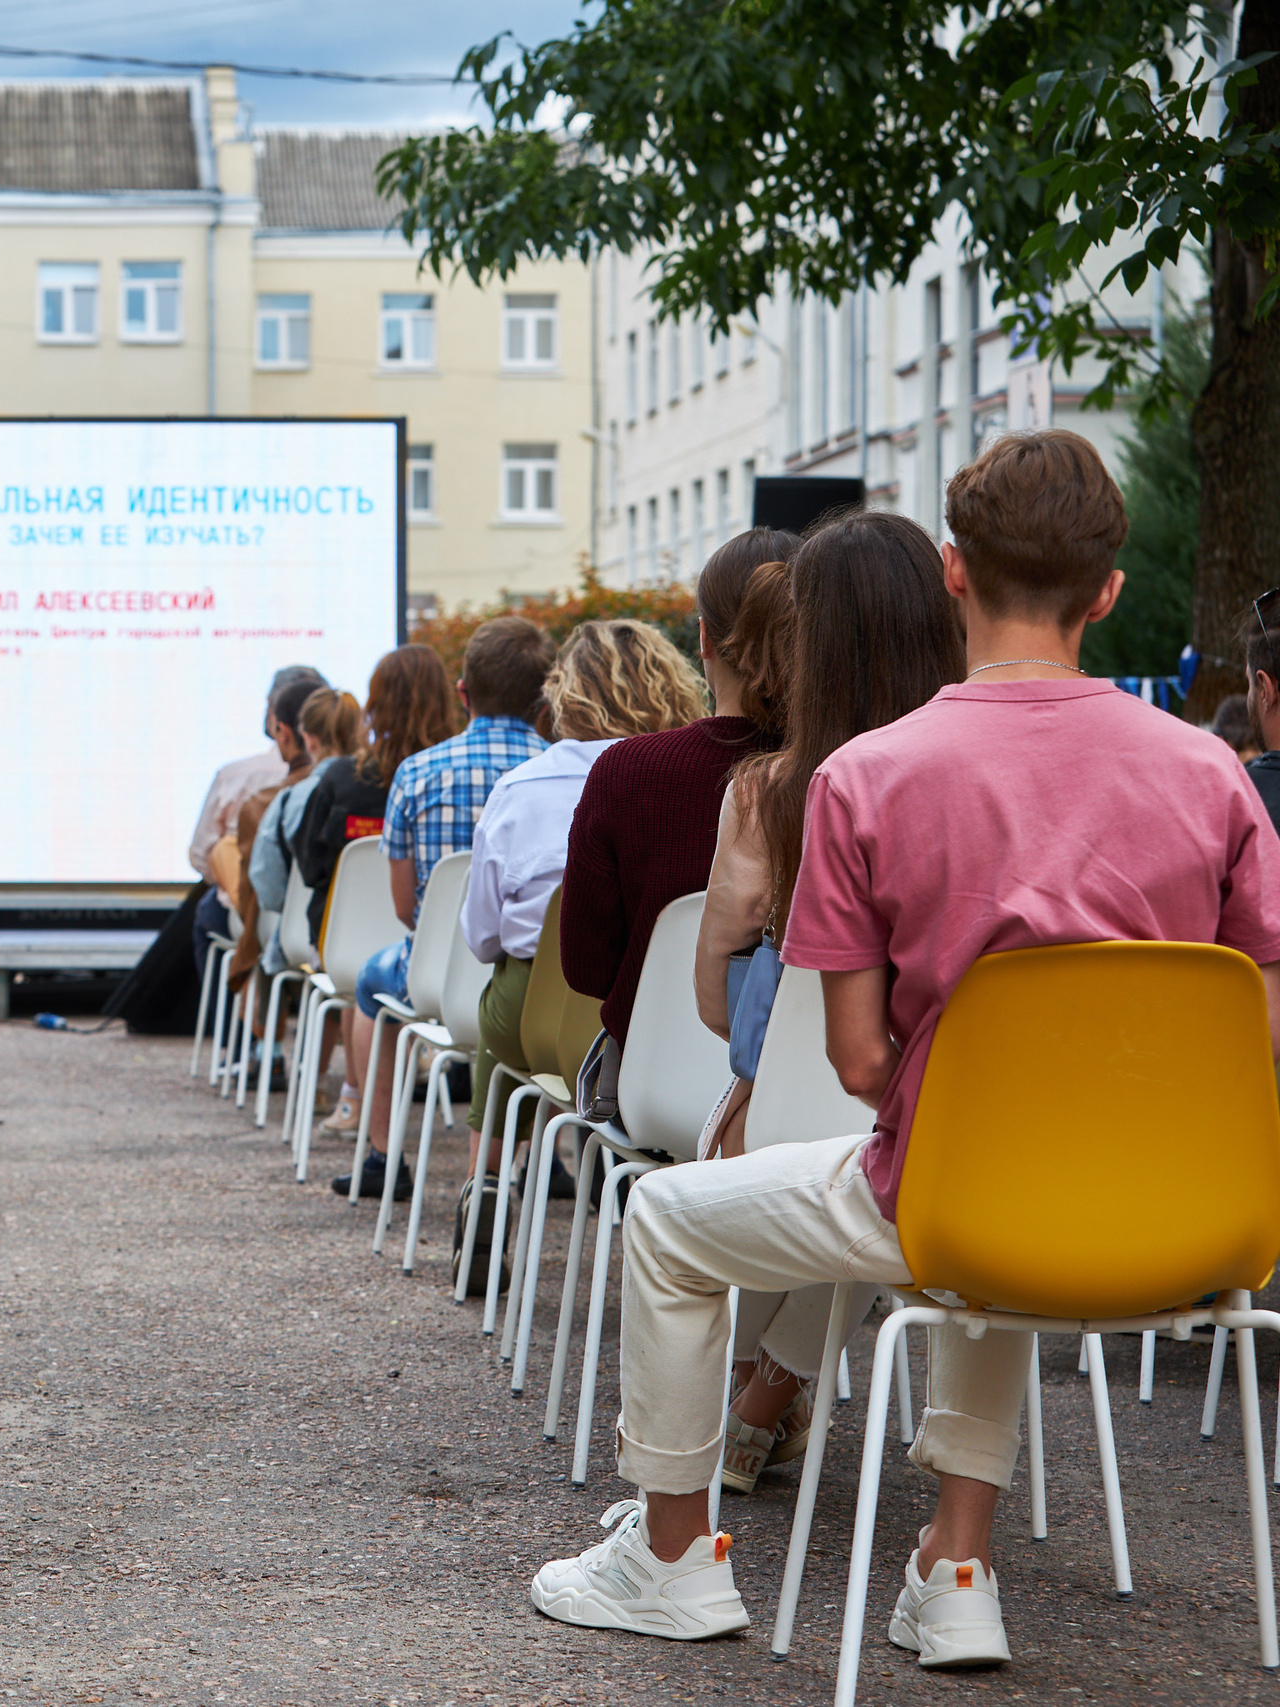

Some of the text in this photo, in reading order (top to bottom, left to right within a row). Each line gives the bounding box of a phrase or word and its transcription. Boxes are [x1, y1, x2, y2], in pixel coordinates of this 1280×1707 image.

[128, 486, 375, 518] ИДЕНТИЧНОСТЬ
[9, 524, 85, 546] ЗАЧЕМ
[100, 525, 129, 546] ЕЕ
[145, 525, 266, 546] ИЗУЧАТЬ?
[35, 586, 216, 611] АЛЕКСЕЕВСКИЙ
[724, 1445, 761, 1475] IKE
